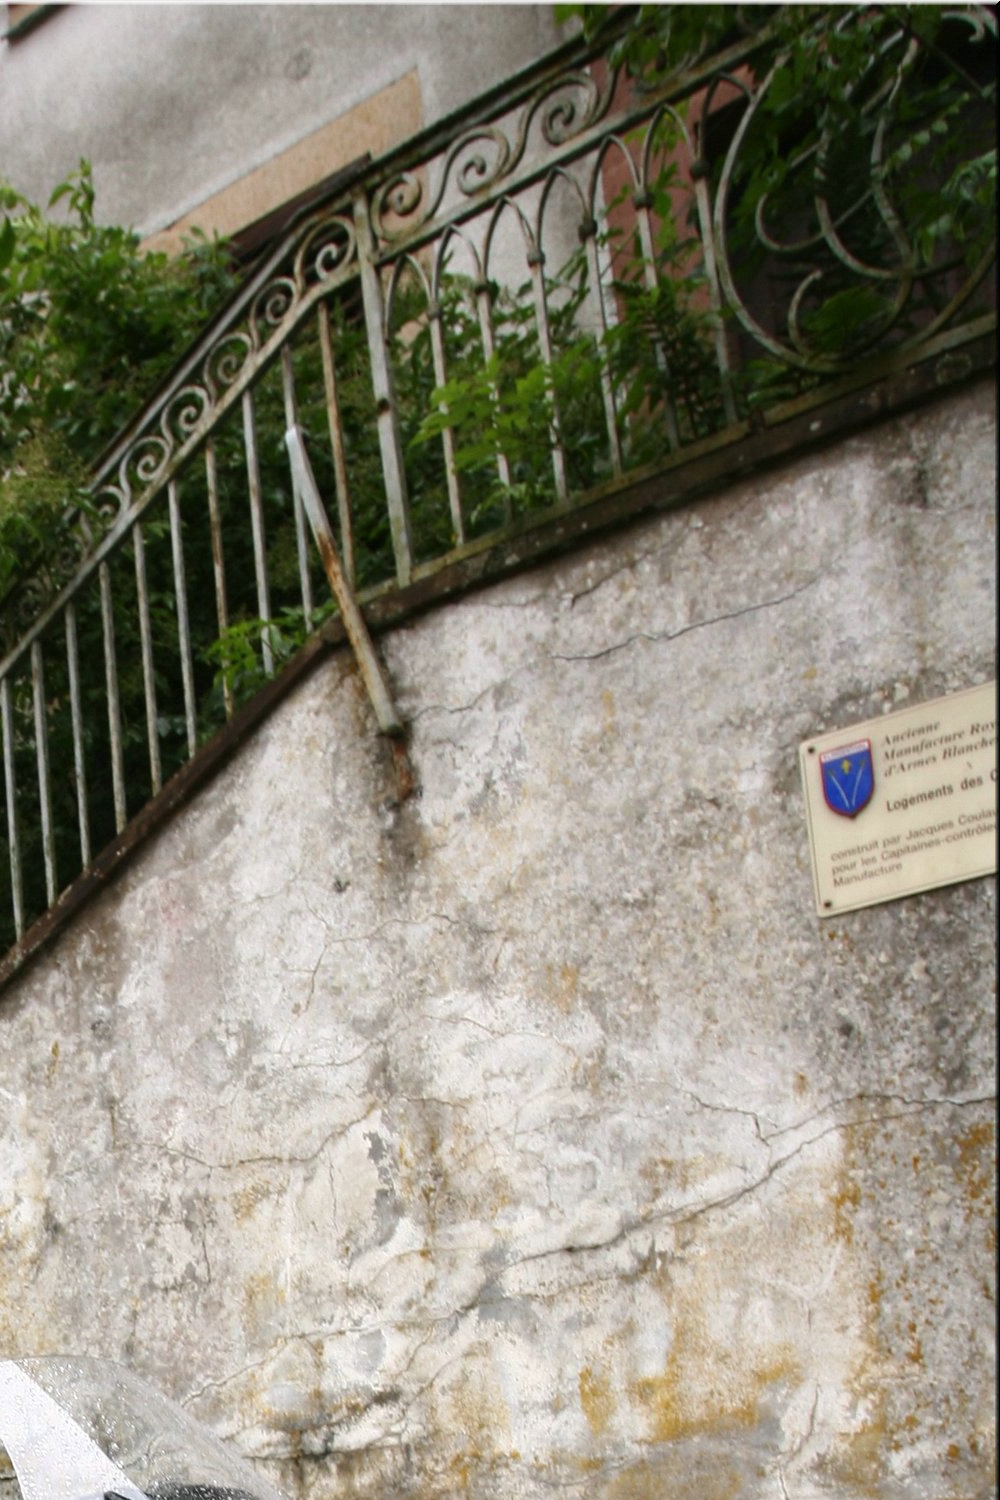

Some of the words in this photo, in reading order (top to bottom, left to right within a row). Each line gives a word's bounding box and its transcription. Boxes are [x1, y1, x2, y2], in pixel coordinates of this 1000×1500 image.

[883, 721, 941, 745] Ancienne
[883, 730, 965, 760] Manufacture
[884, 755, 937, 777] d'Armes
[886, 784, 954, 812] Logements
[960, 776, 983, 790] des
[831, 839, 878, 861] construit
[882, 833, 901, 848] par
[906, 820, 953, 840] Jacques
[832, 861, 857, 876] pour
[861, 855, 877, 867] les
[833, 862, 902, 887] Manufacture
